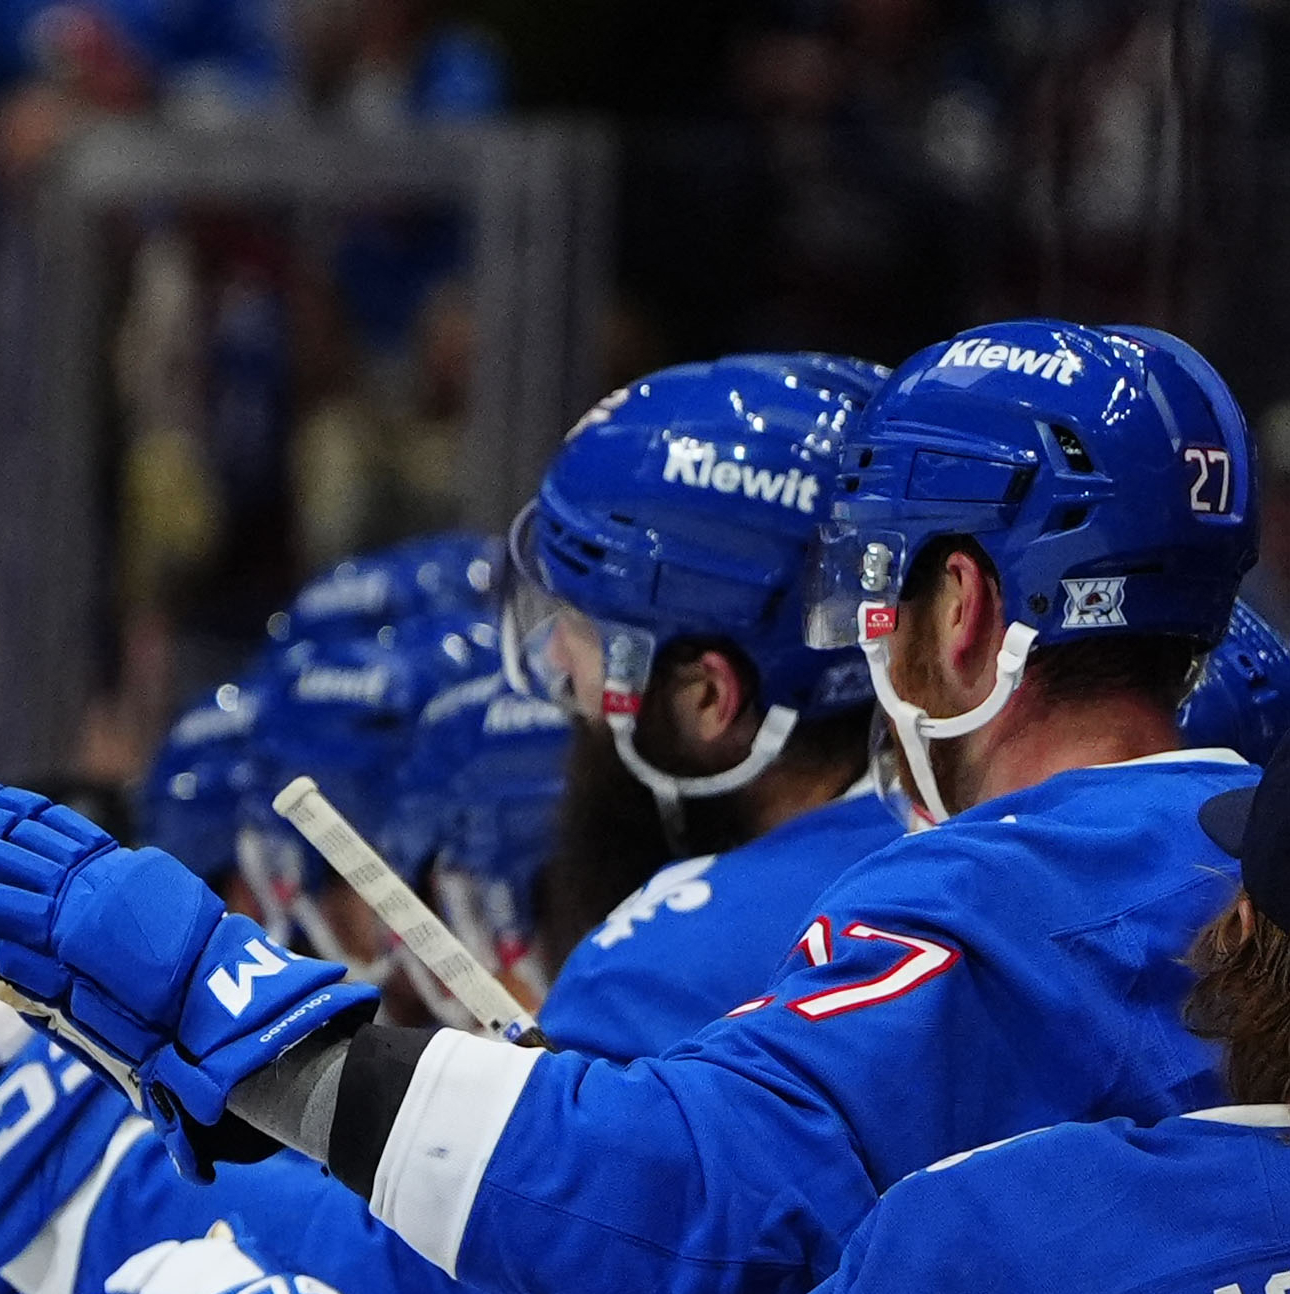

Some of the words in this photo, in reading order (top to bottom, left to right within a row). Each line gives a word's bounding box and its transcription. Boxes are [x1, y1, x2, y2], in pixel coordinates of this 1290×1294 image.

[937, 338, 1084, 386] Kiewit
[1184, 448, 1230, 512] 27
[259, 993, 331, 1043] COLORADO
